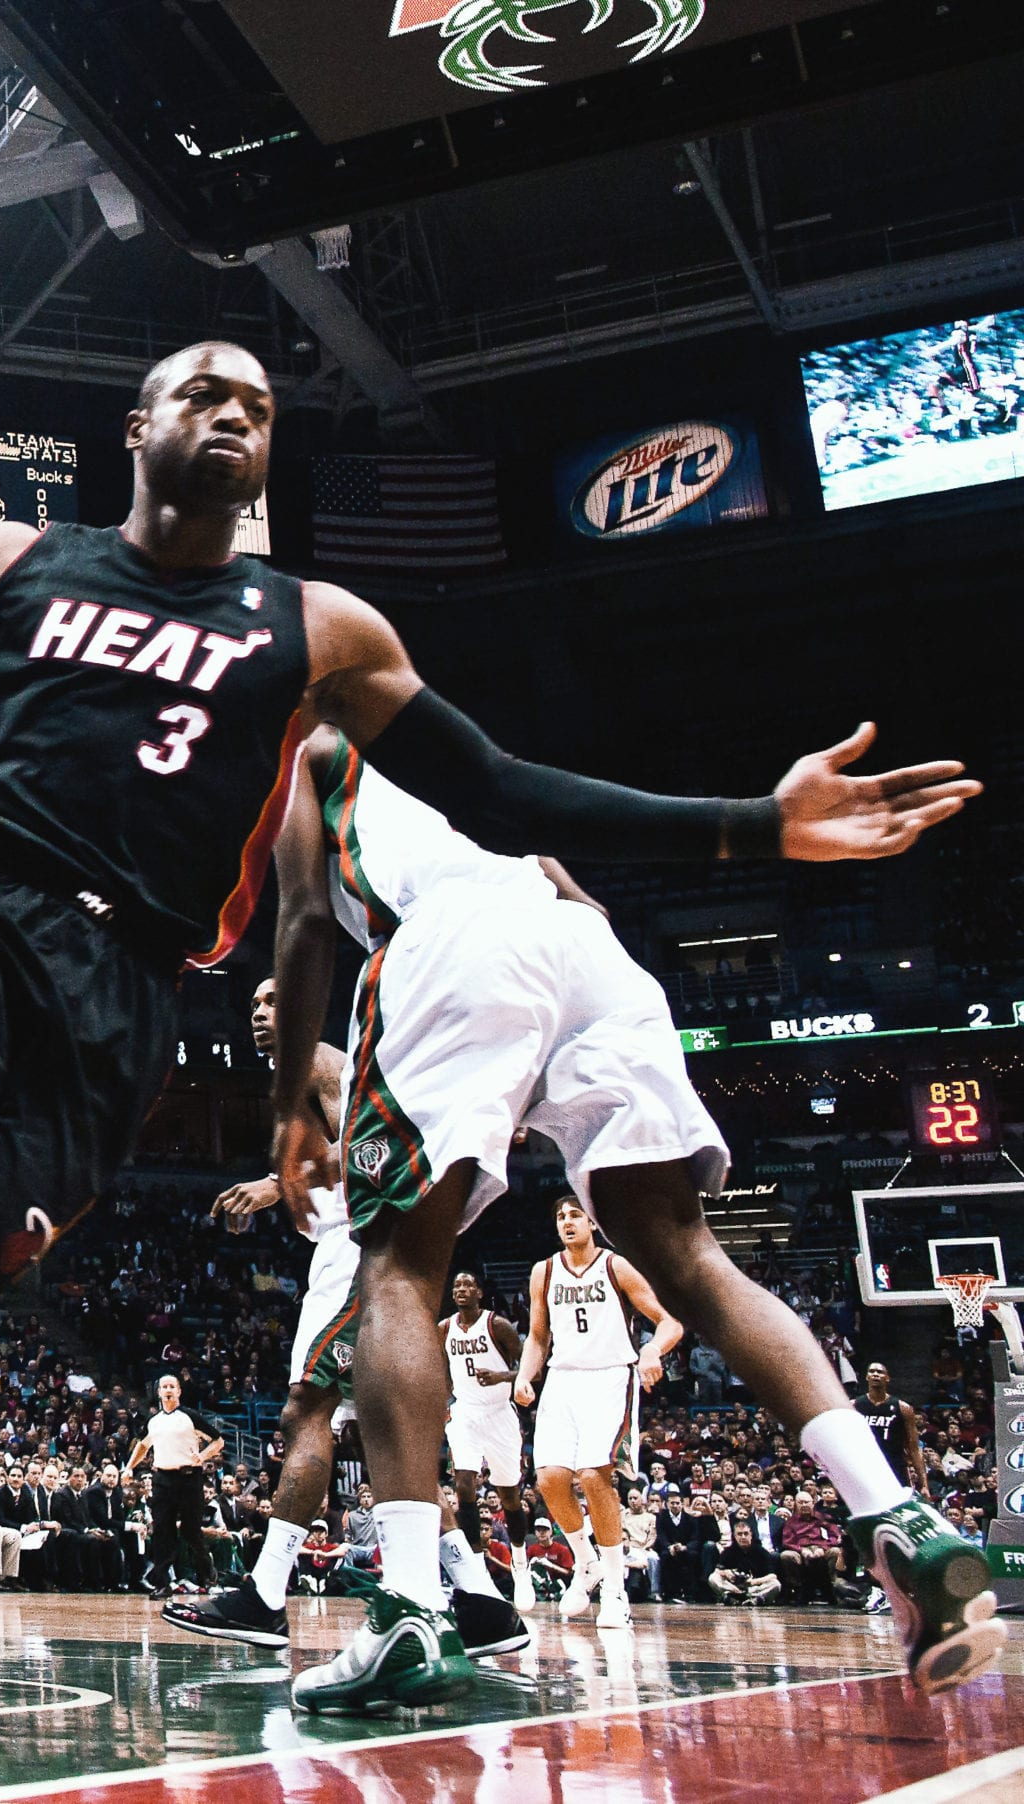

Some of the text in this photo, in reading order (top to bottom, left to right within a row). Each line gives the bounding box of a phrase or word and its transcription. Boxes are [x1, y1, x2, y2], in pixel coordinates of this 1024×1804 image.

[7, 433, 55, 449] TEAM
[21, 447, 78, 467] STATS!
[613, 434, 694, 478] Miller
[26, 467, 74, 485] Bucks
[36, 489, 47, 502] 0
[37, 503, 48, 517] 0
[27, 597, 274, 692] HEAT
[135, 702, 213, 776] 3
[769, 1012, 875, 1040] BUCKS
[967, 1003, 993, 1028] 2
[929, 1079, 981, 1104] 8:37
[928, 1104, 979, 1144] 22
[553, 1280, 606, 1306] BUCKS
[575, 1307, 589, 1334] 6
[450, 1335, 488, 1356] BUCKS
[465, 1357, 475, 1377] 8
[883, 1428, 889, 1440] 1
